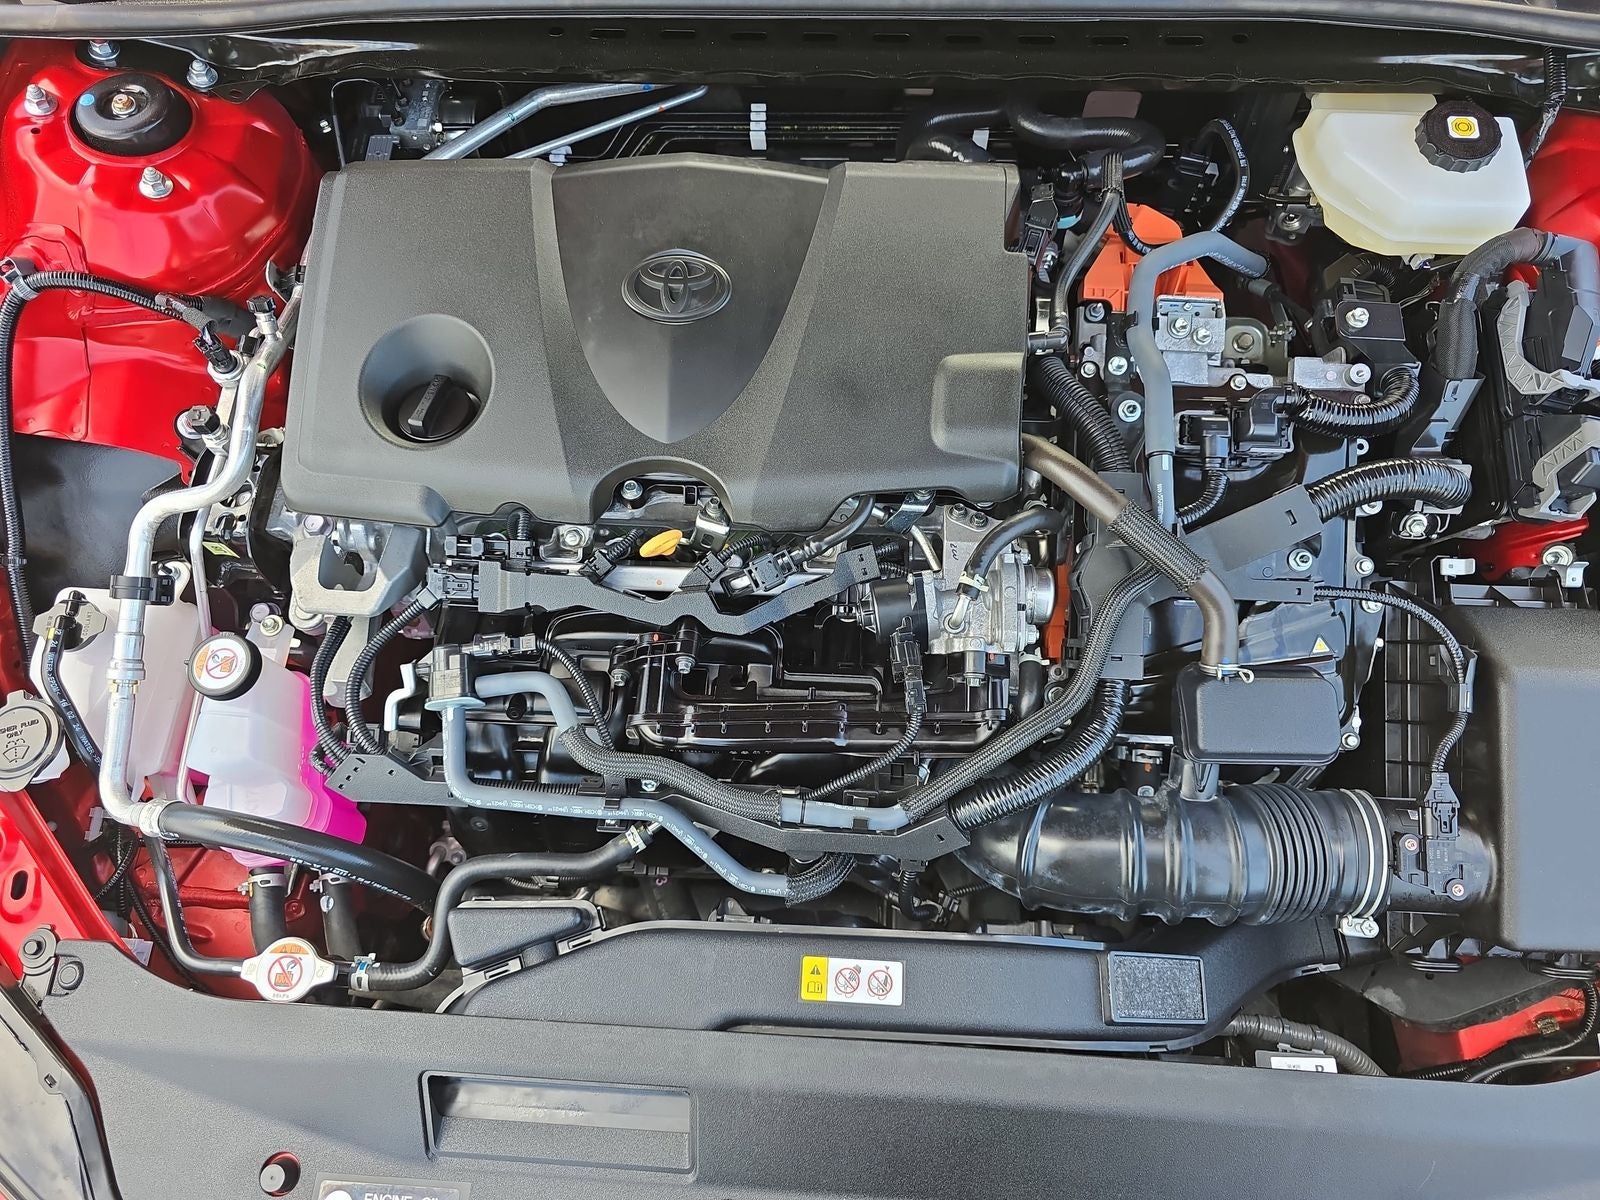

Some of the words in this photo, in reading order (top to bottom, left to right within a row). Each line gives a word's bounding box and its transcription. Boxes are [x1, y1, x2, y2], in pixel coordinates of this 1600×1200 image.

[46, 651, 56, 672] WATER
[80, 734, 95, 755] WATER
[20, 719, 39, 728] FLUID
[6, 729, 24, 739] ONLY
